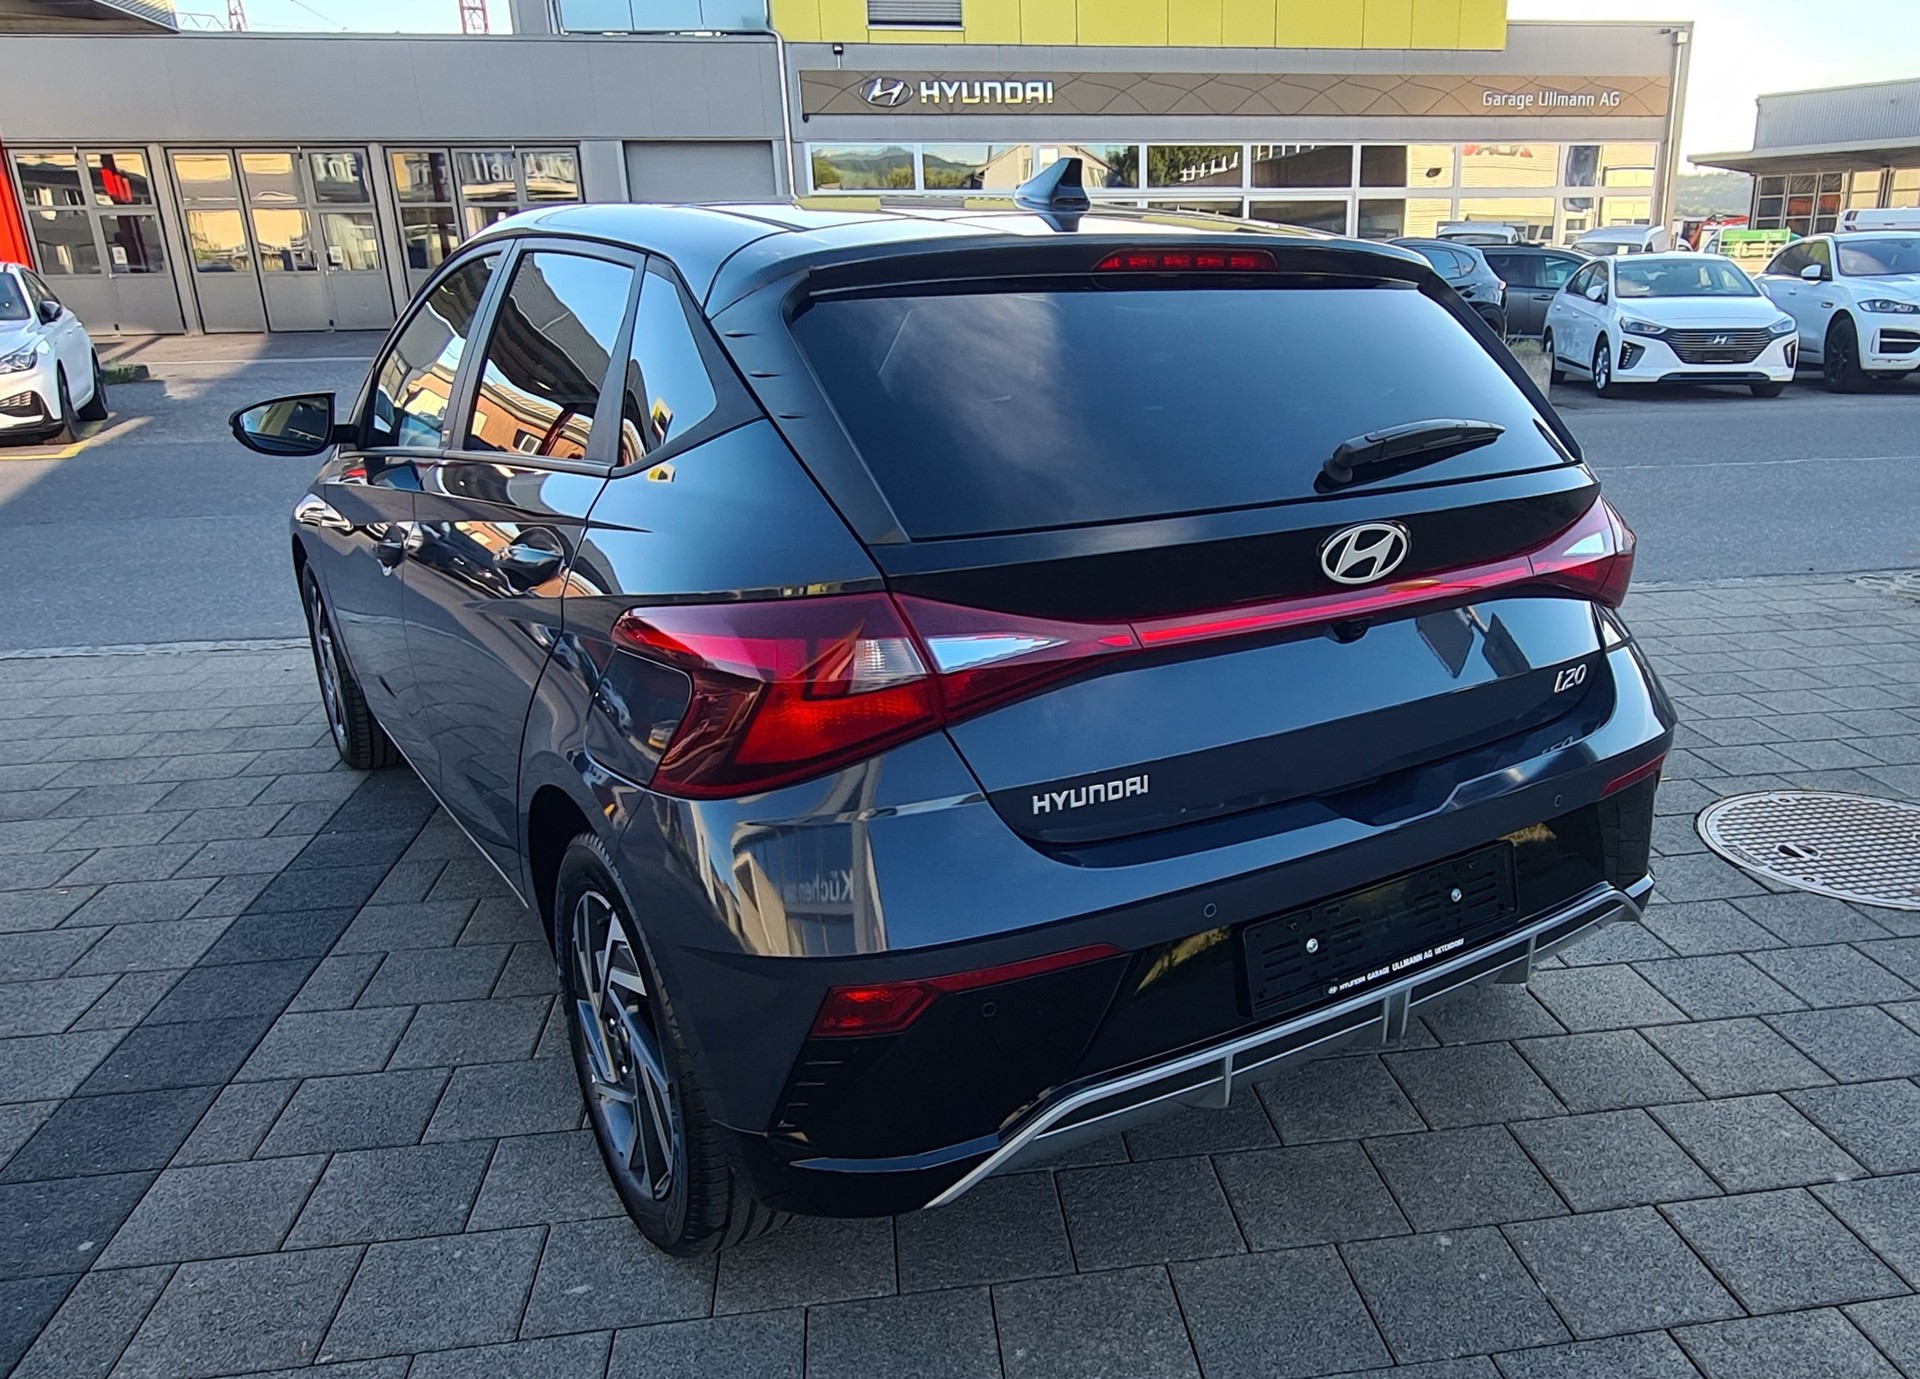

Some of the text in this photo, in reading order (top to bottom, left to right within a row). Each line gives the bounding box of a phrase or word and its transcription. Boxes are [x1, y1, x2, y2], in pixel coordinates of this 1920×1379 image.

[919, 80, 1055, 104] HYUNDAI
[1482, 91, 1621, 110] Garage Ullmann AG
[1032, 774, 1149, 815] HYUNDAI
[1366, 966, 1390, 981] GARAGE
[1391, 952, 1423, 971] ULLMANN
[1423, 949, 1433, 960] AG
